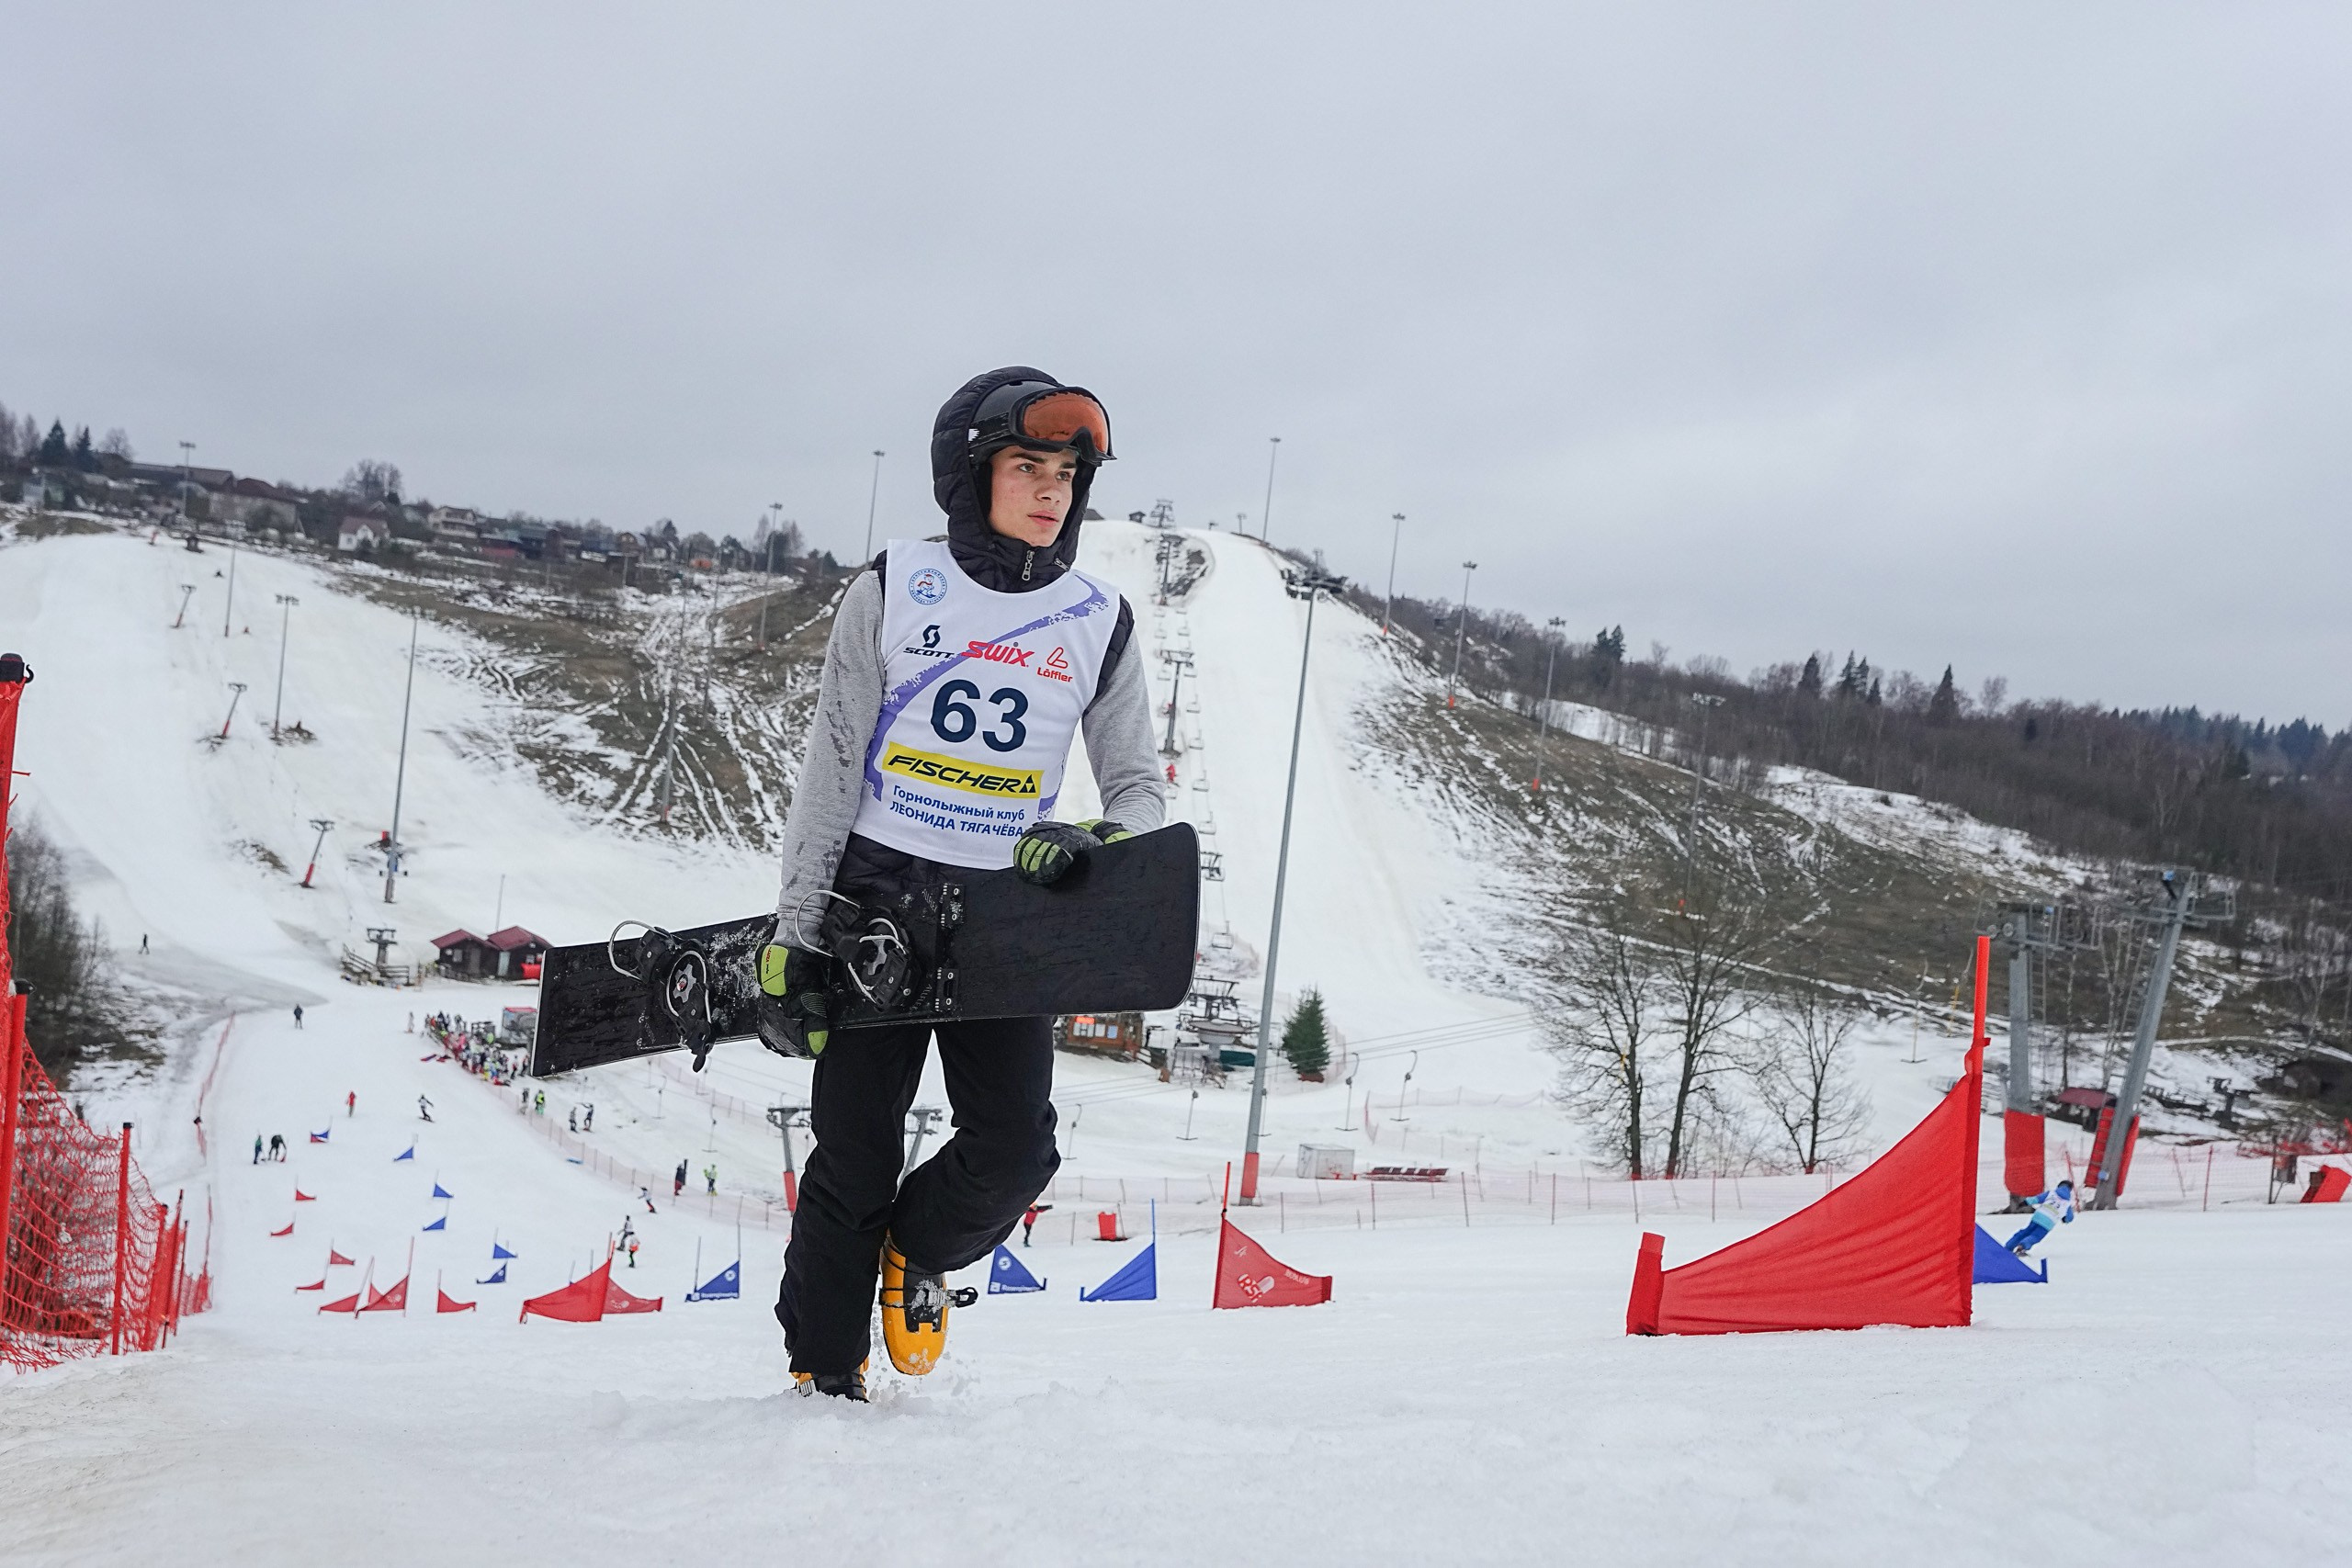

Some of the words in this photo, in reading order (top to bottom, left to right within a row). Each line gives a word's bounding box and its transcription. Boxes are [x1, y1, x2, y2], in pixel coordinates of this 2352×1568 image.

[903, 647, 956, 659] SCOTT
[931, 679, 1029, 752] 63
[888, 754, 1022, 794] FISCHER
[889, 801, 956, 830] ЛЕОНИДА
[960, 820, 1024, 838] ТЯГАЧЁВА
[893, 784, 994, 818] Горнолыжный
[997, 808, 1025, 823] клуб
